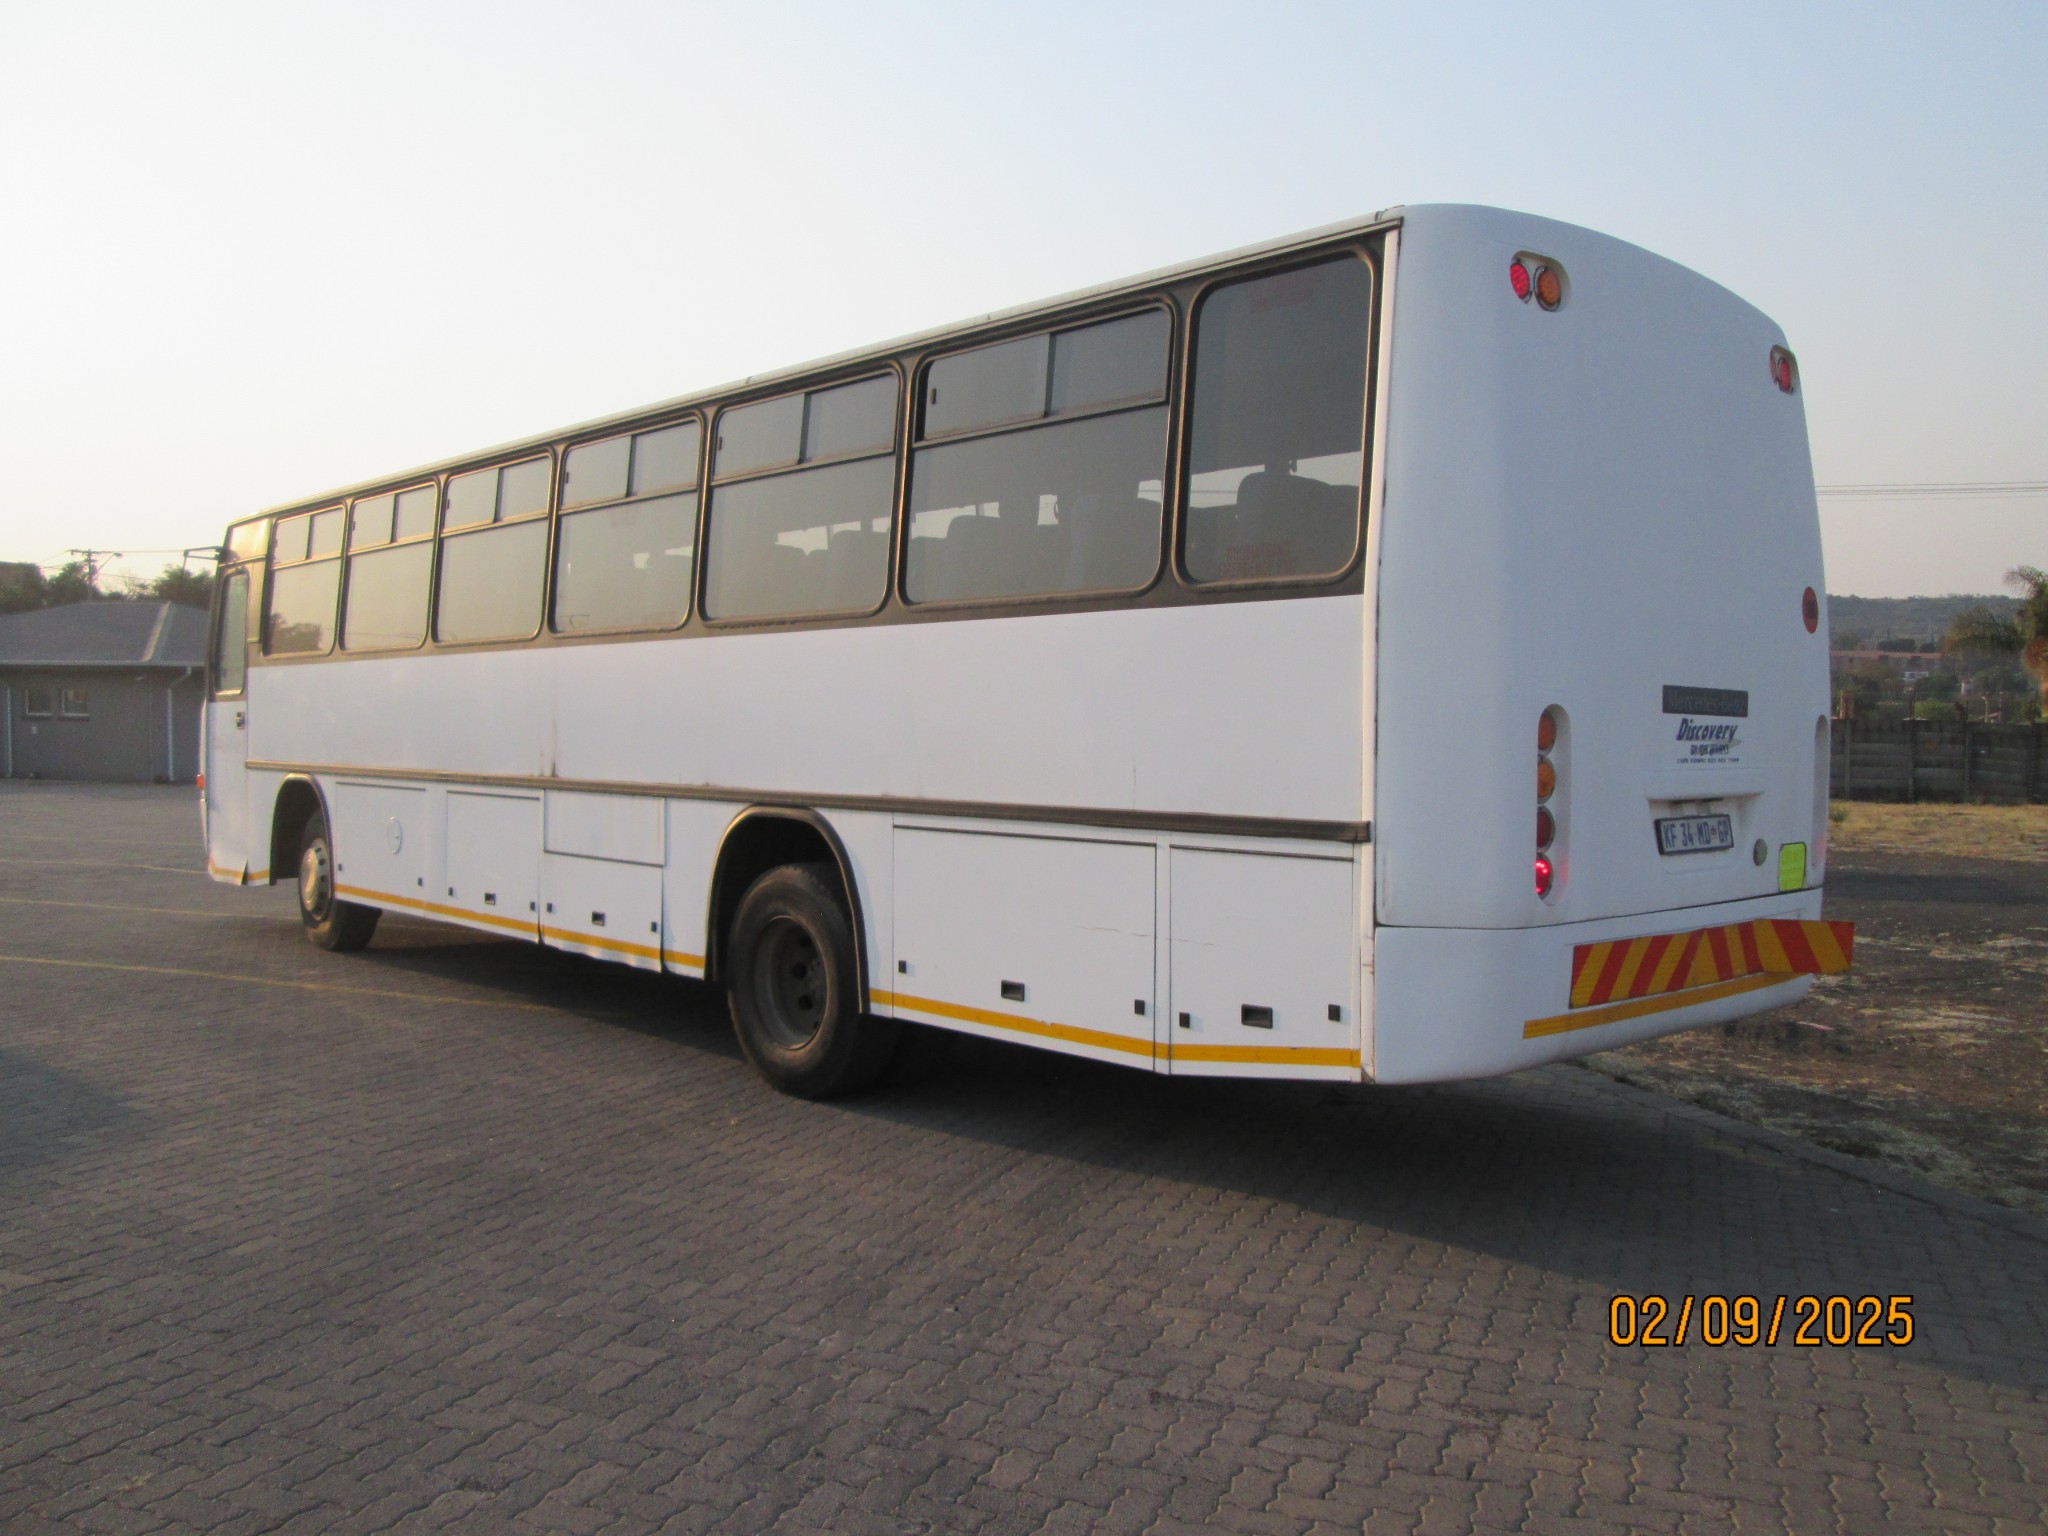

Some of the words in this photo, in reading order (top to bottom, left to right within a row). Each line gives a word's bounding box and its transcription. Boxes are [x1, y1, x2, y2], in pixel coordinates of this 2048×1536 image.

[1676, 717, 1739, 743] Discovery
[1663, 823, 1677, 848] KF
[1680, 822, 1694, 847] 34
[1696, 821, 1711, 845] MD
[1717, 820, 1729, 843] GP
